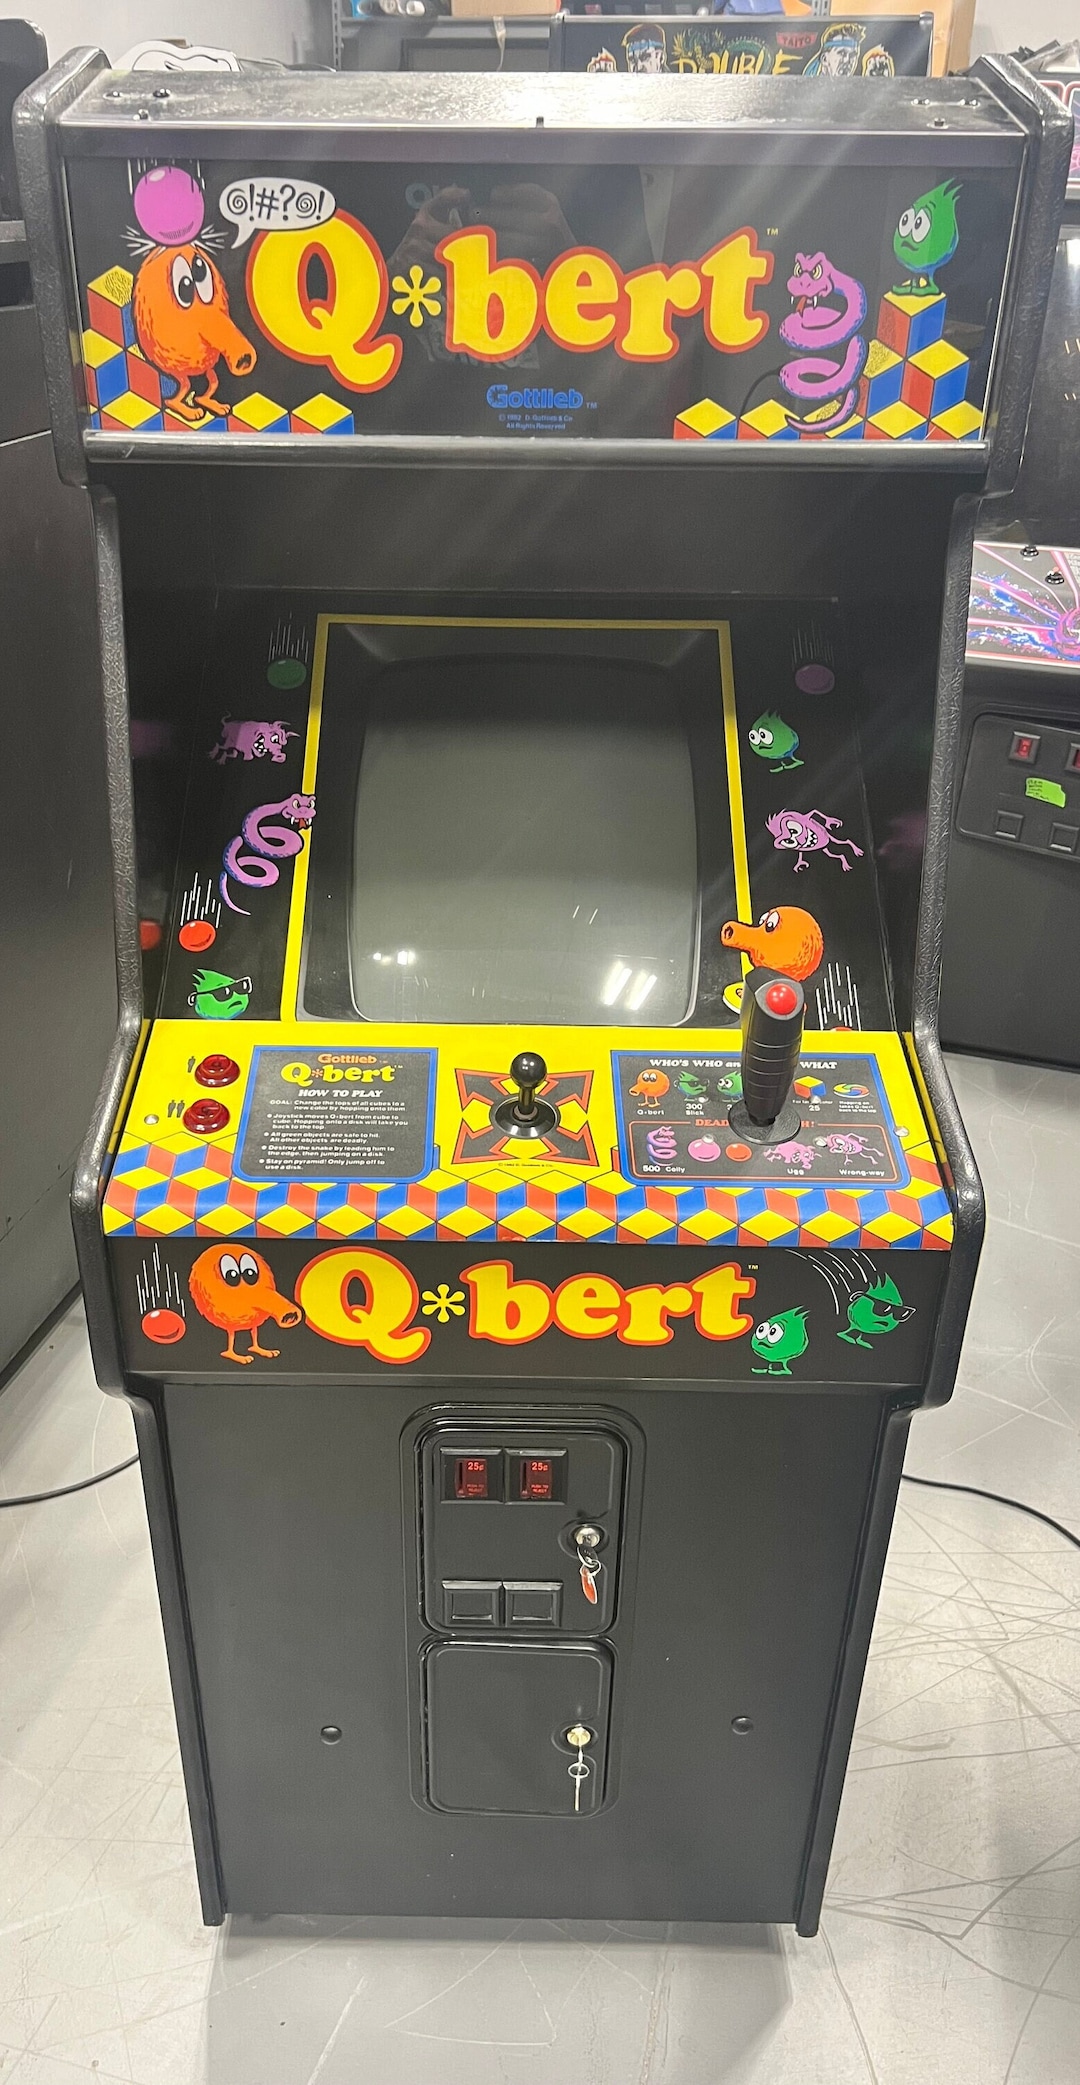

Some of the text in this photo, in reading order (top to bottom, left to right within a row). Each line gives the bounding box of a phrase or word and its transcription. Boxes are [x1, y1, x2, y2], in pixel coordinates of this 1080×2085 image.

[783, 35, 811, 48] TAITO
[486, 384, 583, 409] Gottlieb
[515, 422, 536, 430] Rights
[536, 422, 566, 430] Reserved
[318, 1053, 378, 1064] Gottlieb
[649, 1059, 689, 1067] WHO'S
[692, 1060, 724, 1068] WHO
[800, 1061, 838, 1069] WHAT
[298, 1089, 384, 1098] HOW TO PLAY
